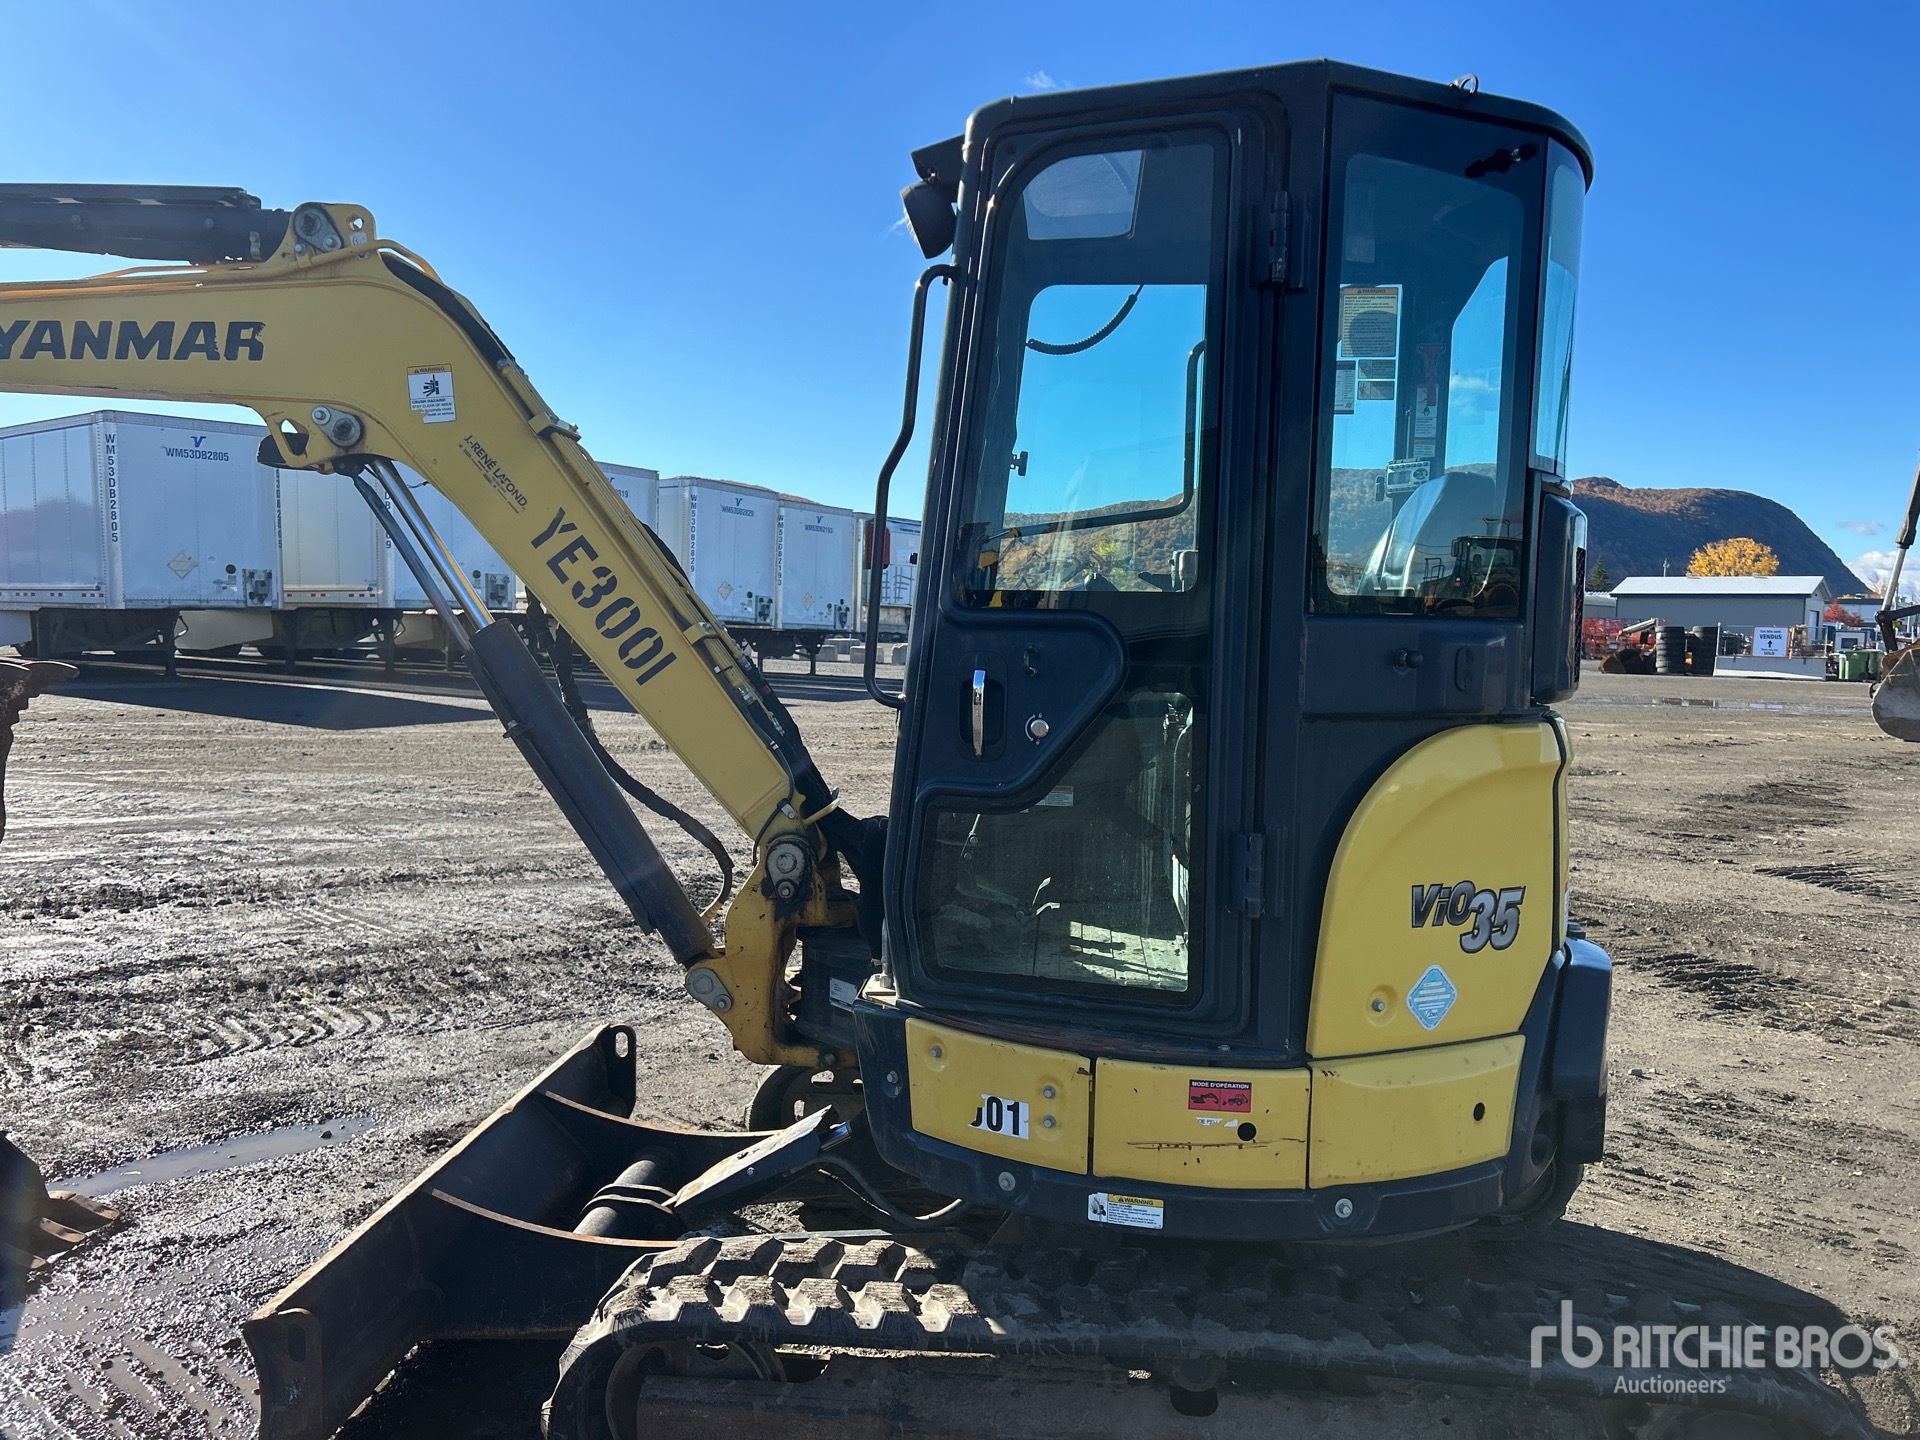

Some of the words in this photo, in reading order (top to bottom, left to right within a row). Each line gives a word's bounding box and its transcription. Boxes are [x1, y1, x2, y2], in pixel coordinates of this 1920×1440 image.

[0, 320, 265, 361] YANMAR
[165, 447, 229, 462] WM53DB2805
[104, 433, 118, 542] WM53DB2805
[617, 489, 629, 499] 819
[690, 494, 698, 573] WM53DB2829
[1124, 1197, 1154, 1206] WARNING
